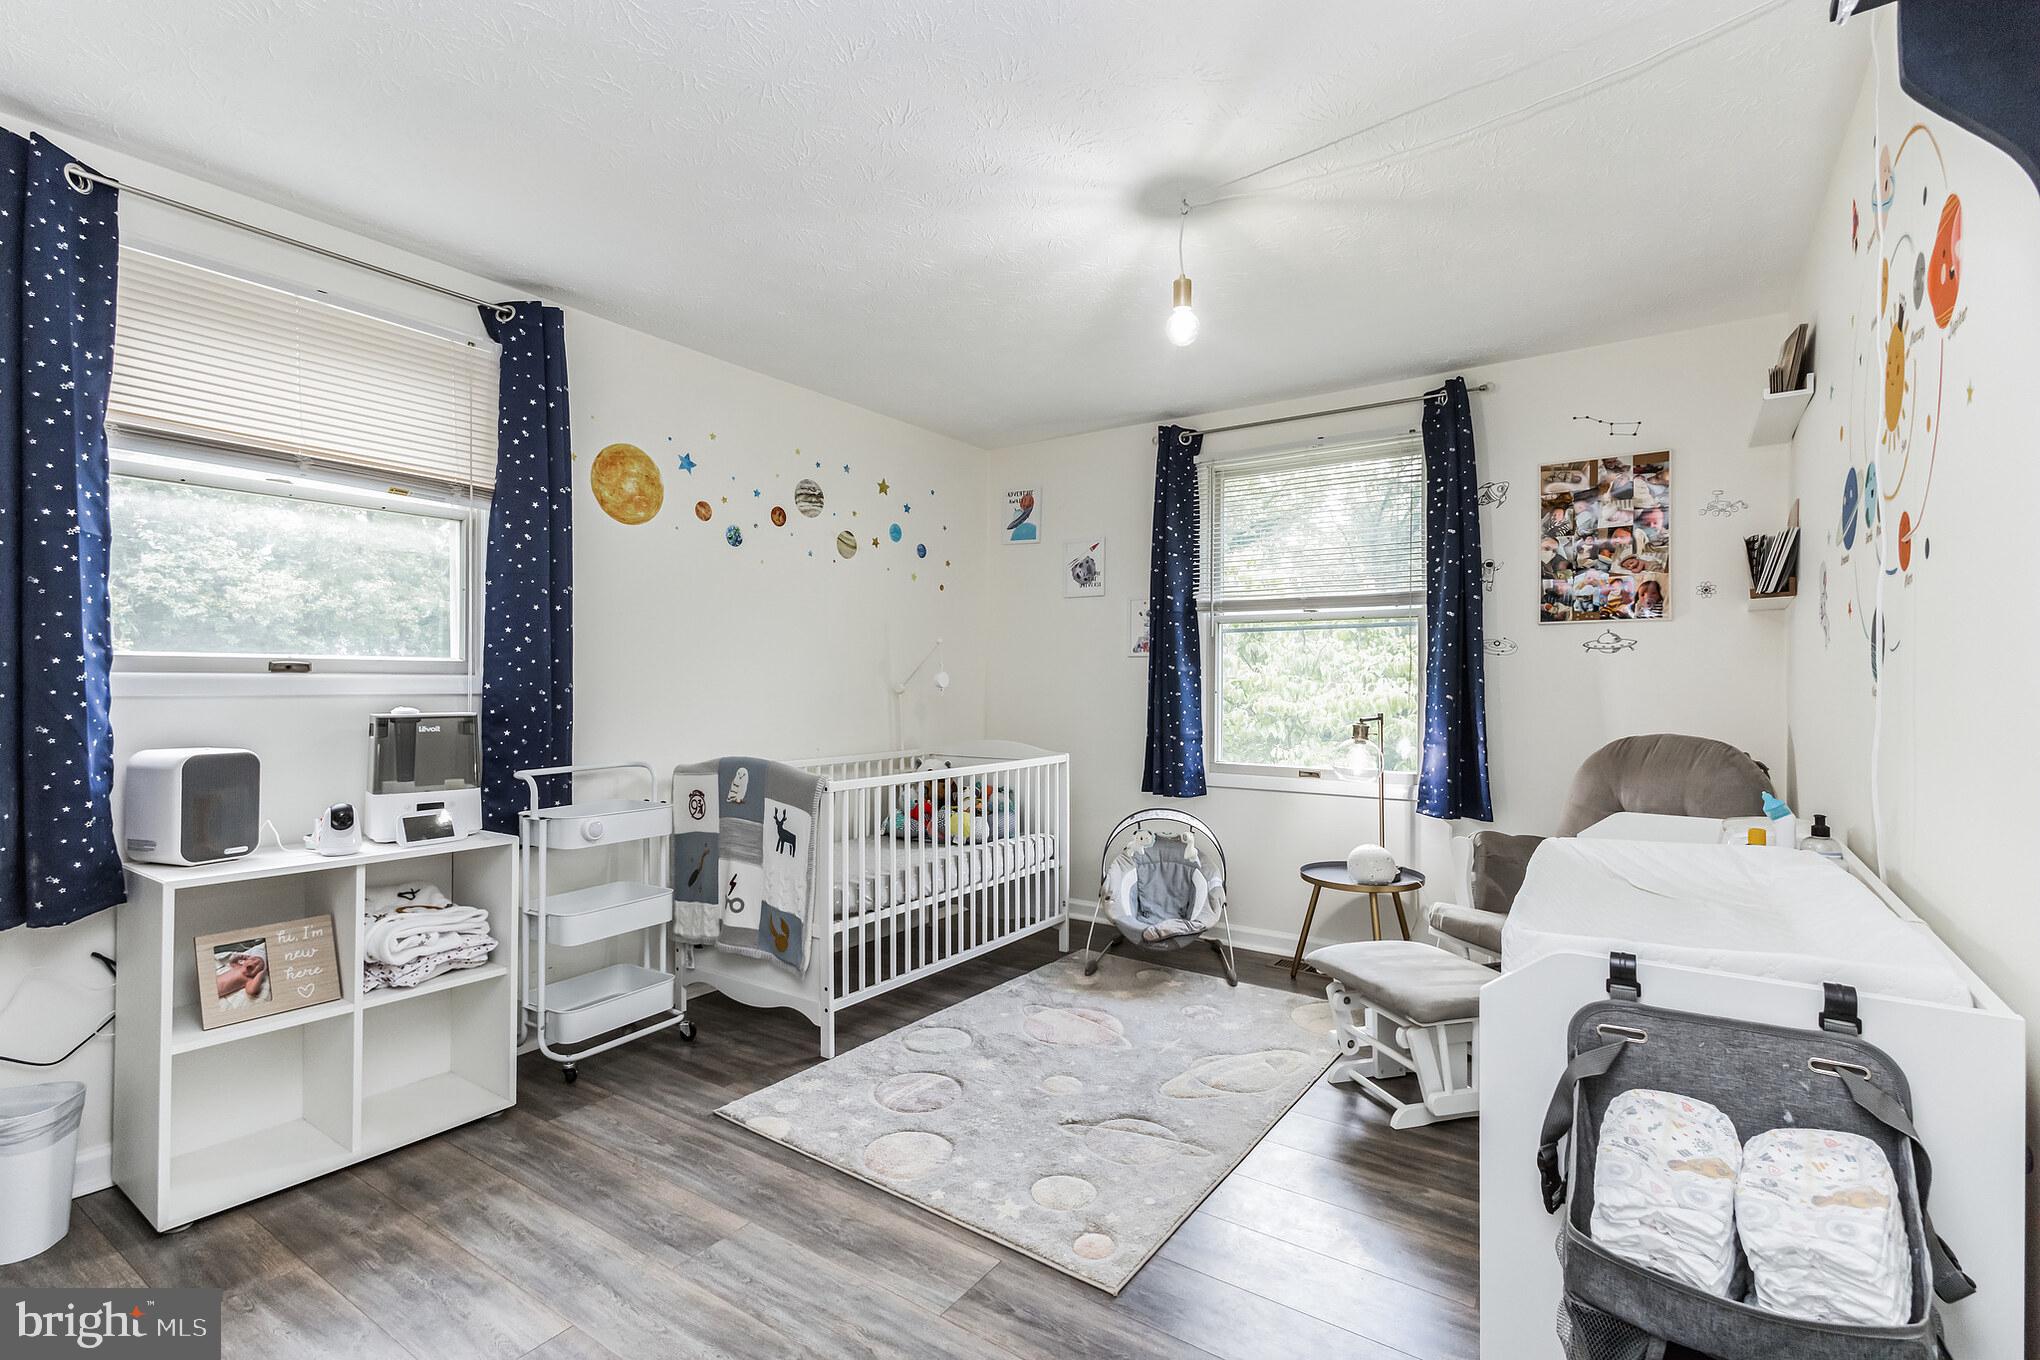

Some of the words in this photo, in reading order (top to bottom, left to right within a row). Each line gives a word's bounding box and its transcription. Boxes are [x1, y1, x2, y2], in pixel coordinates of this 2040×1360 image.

[418, 725, 441, 733] Levoit
[302, 925, 323, 940] I'm
[284, 947, 319, 961] new
[283, 966, 323, 980] here
